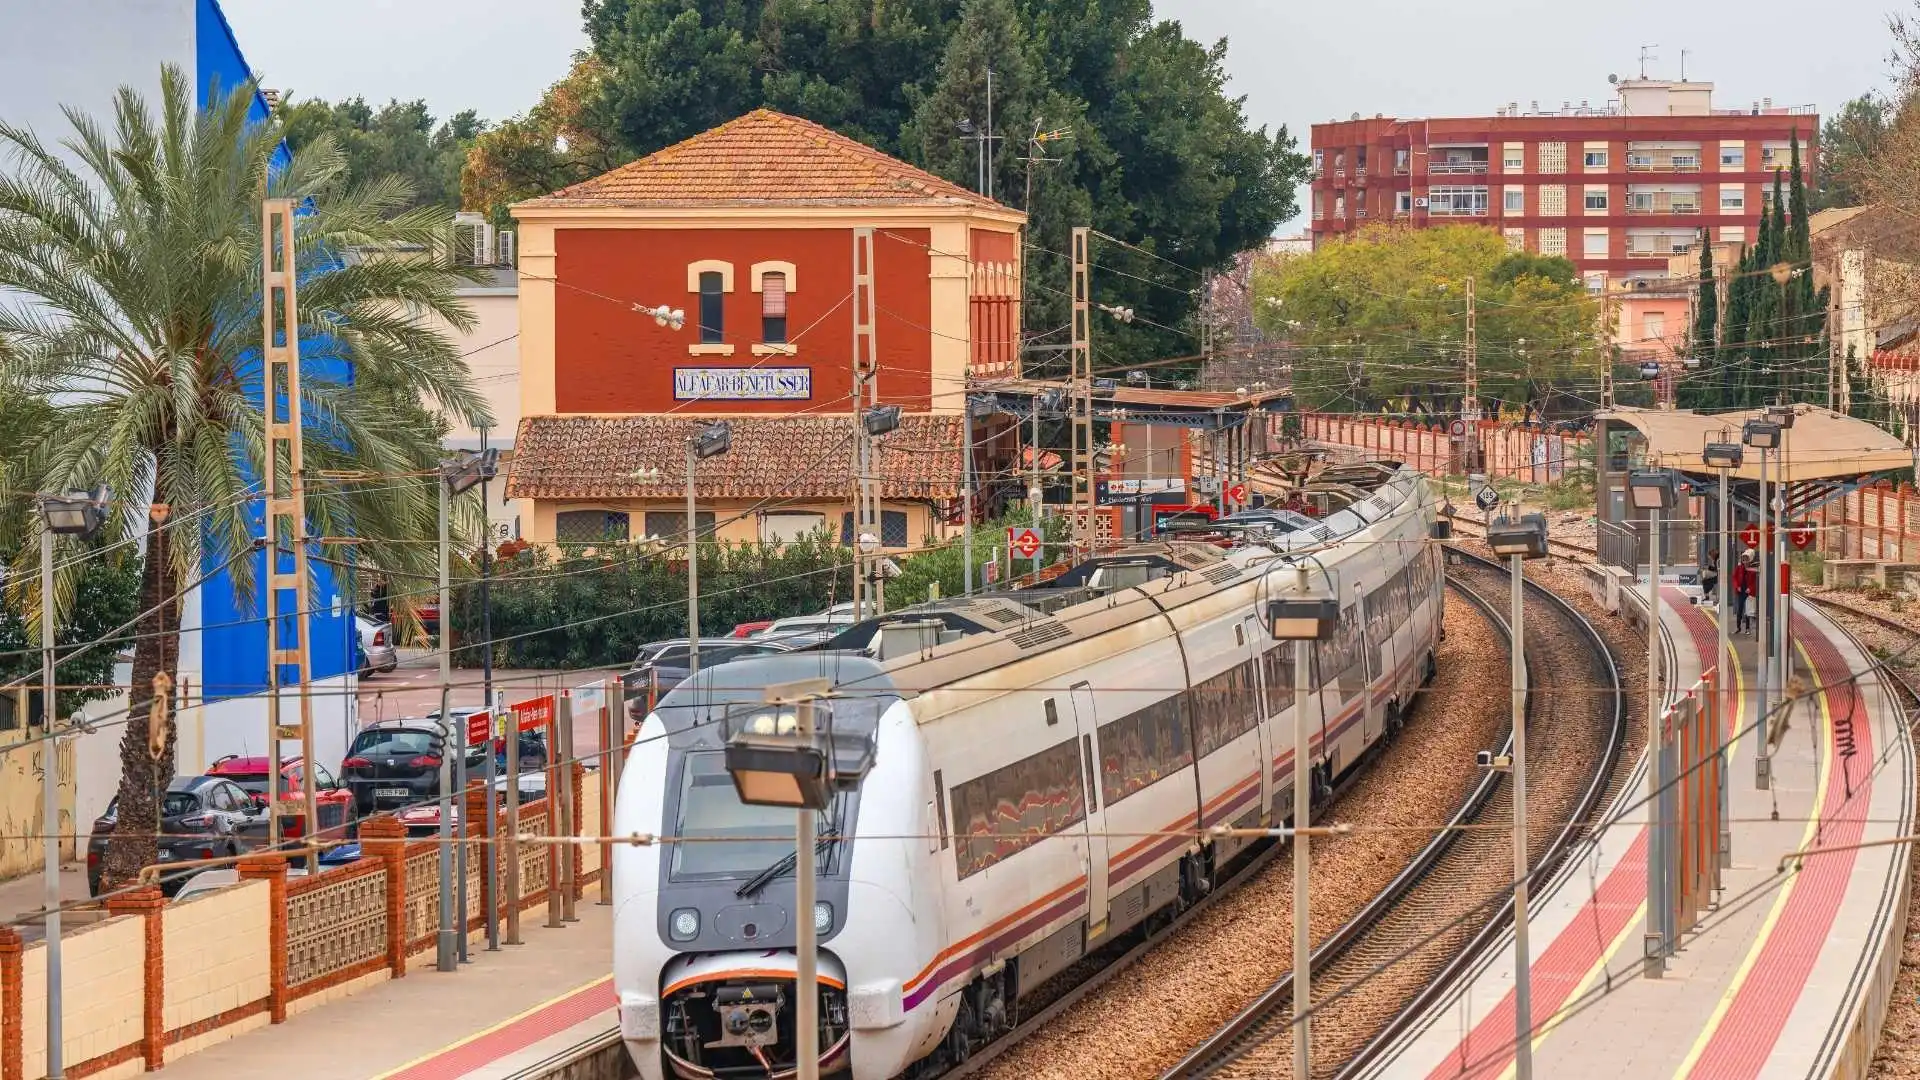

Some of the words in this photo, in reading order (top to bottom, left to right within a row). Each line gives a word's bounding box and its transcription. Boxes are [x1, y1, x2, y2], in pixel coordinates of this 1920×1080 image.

[1236, 486, 1245, 500] 2
[1023, 535, 1034, 551] 2
[1747, 529, 1757, 544] 1
[1796, 528, 1806, 544] 3
